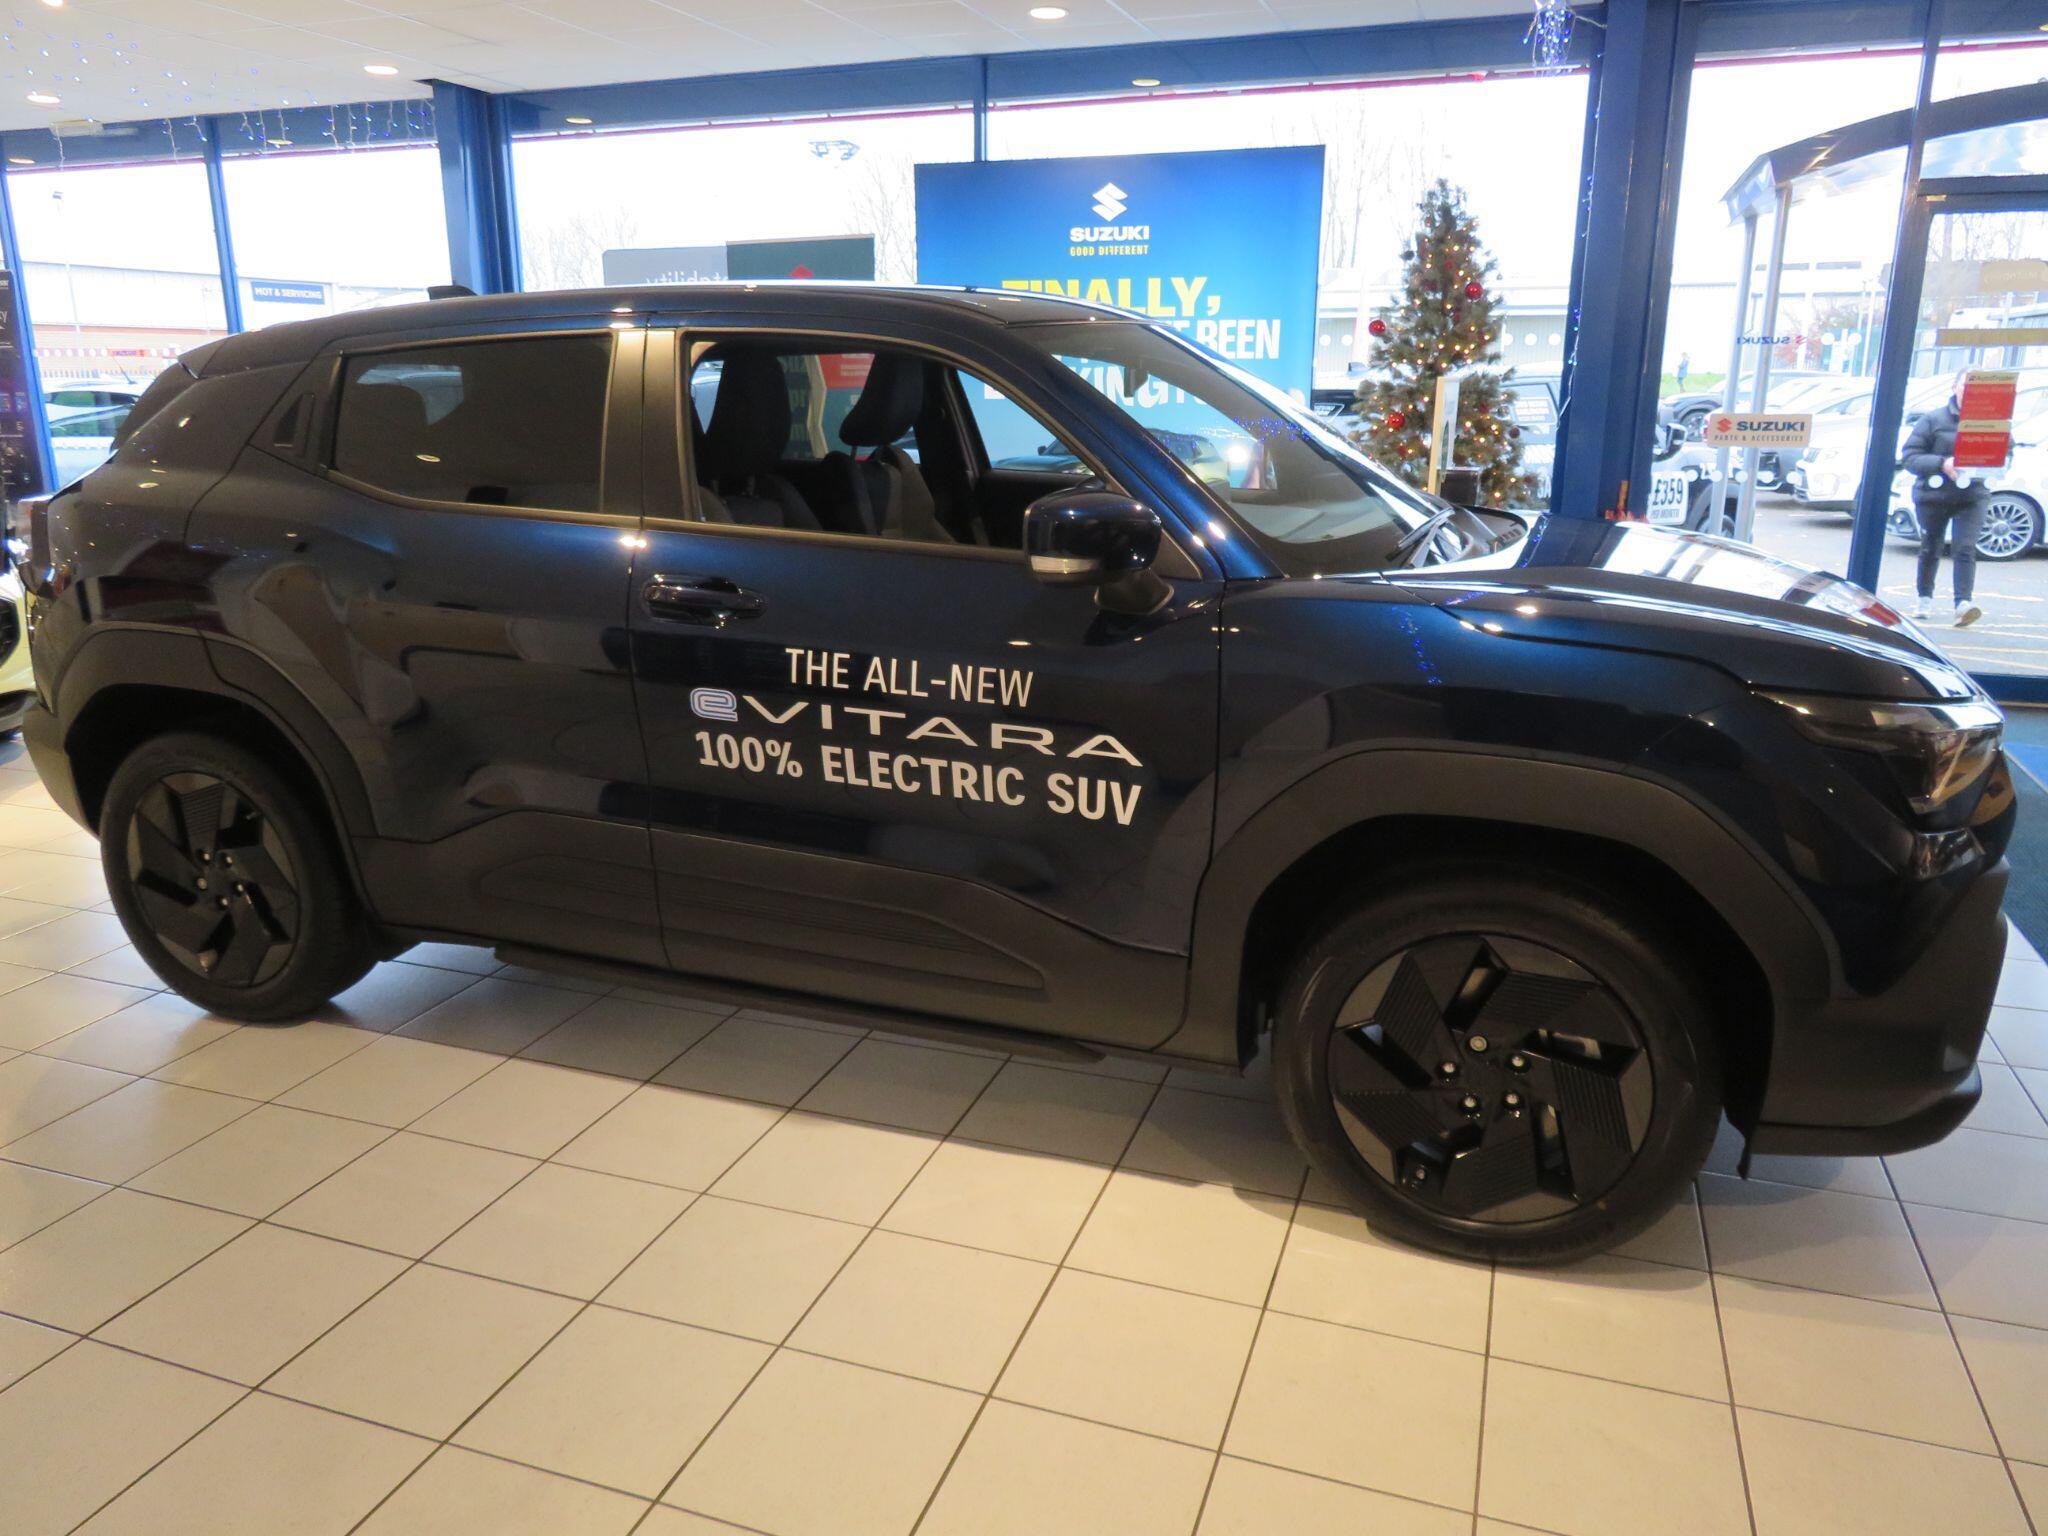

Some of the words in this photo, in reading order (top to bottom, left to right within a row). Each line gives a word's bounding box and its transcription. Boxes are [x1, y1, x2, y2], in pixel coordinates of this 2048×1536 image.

[1070, 226, 1150, 242] SUZUKI
[1070, 246, 1095, 256] GOOD
[1099, 245, 1149, 256] DIFFERENT
[1002, 277, 1221, 317] ALLY,
[1196, 319, 1280, 359] BEEN
[1736, 421, 1805, 432] SUZUKI
[1751, 434, 1804, 442] ACCESSORIES
[1652, 478, 1684, 506] £359
[785, 647, 850, 689] THE
[863, 656, 1034, 708] ALL-NEW
[695, 731, 803, 778] 100%
[821, 745, 1026, 807] ELECTRIC
[1047, 772, 1142, 826] SUV
